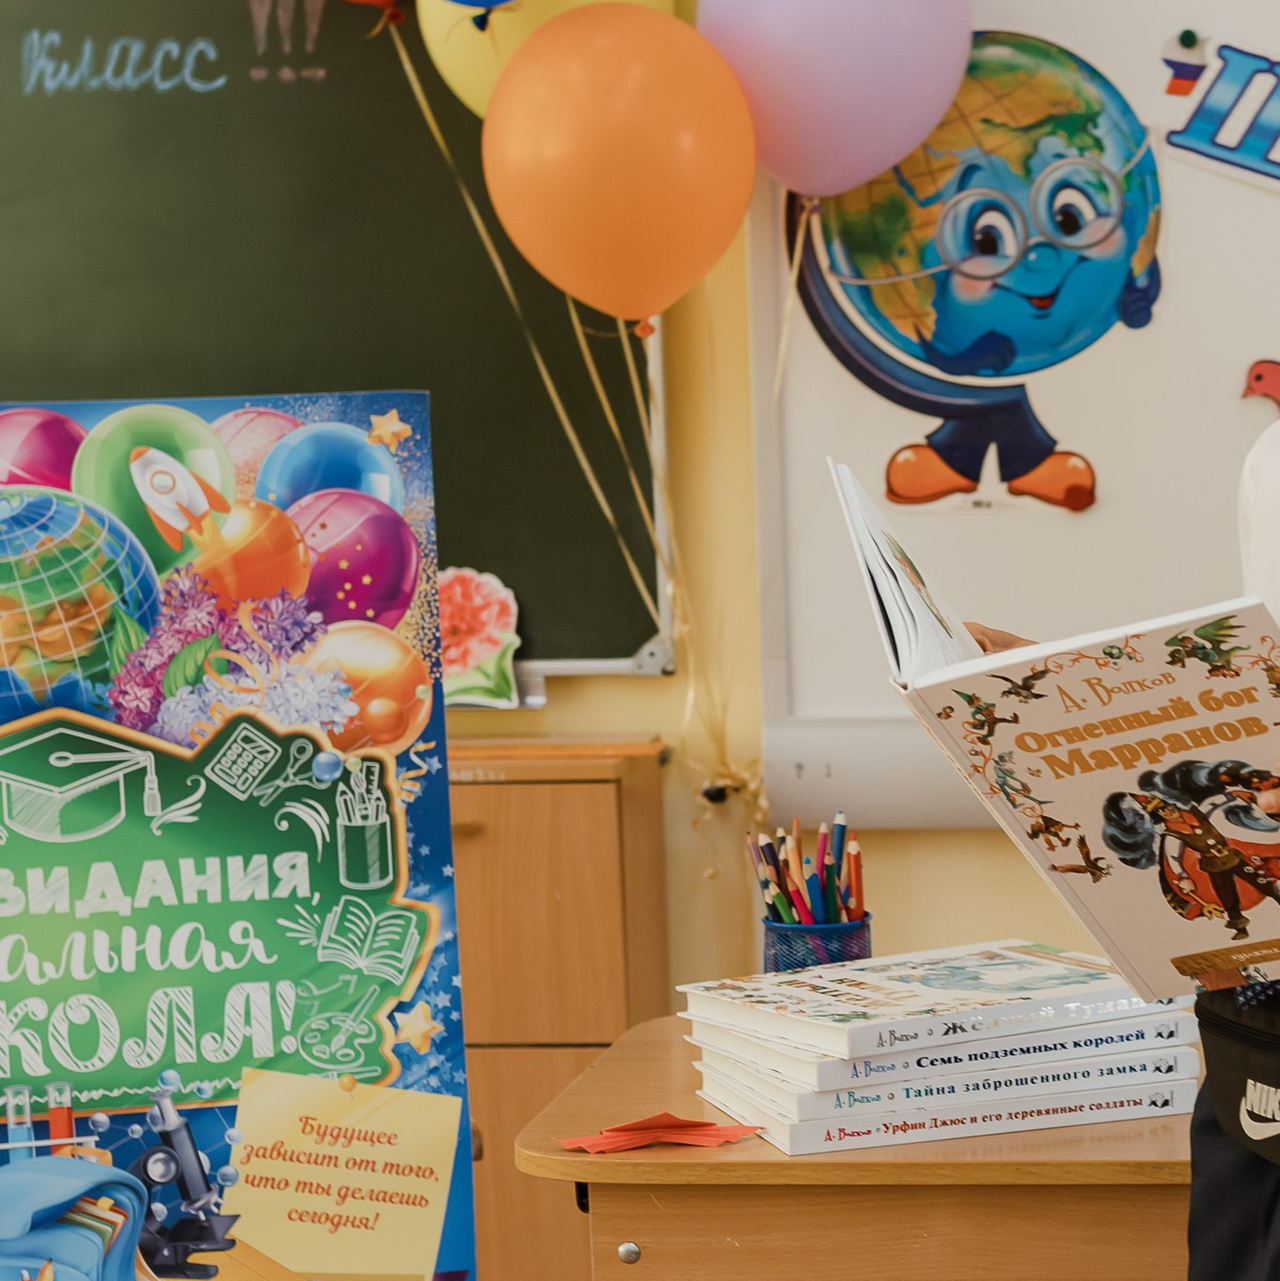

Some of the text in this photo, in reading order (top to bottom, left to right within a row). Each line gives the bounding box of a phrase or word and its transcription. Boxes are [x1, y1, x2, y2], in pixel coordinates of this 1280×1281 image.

[1060, 671, 1177, 716] А. Волков
[1013, 684, 1260, 756] Огненный бог
[1040, 716, 1270, 781] Марранов
[0, 851, 321, 919] ВИДАНИЯ,
[915, 1052, 964, 1069] Семь
[968, 1040, 1067, 1062] подземных
[1072, 1028, 1146, 1049] королей
[902, 1083, 956, 1100] Тайна
[963, 1068, 1091, 1094] заброшенного
[1096, 1061, 1148, 1078] замка
[299, 1116, 399, 1149] Будущее
[882, 1119, 927, 1136] Урфин
[929, 1116, 967, 1133] Джюс
[982, 1111, 1004, 1125] его
[1006, 1102, 1085, 1122] деревянные
[1088, 1096, 1144, 1112] солдаты
[240, 1140, 439, 1182] зависит от того,
[295, 1178, 332, 1197] ты
[336, 1184, 430, 1208] делаешь
[287, 1207, 380, 1234] сегодня!
